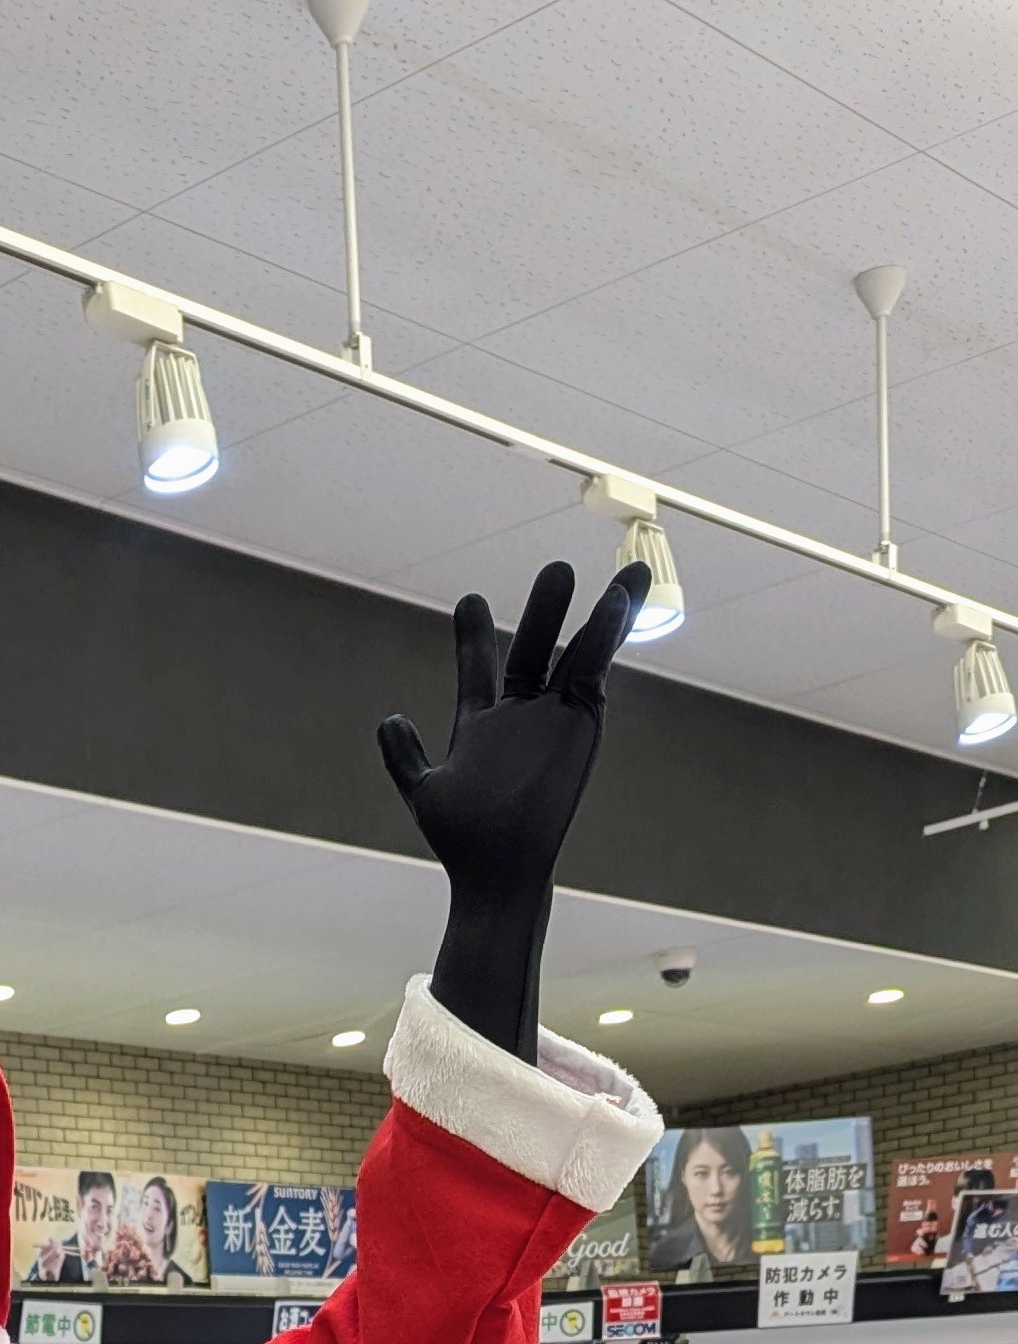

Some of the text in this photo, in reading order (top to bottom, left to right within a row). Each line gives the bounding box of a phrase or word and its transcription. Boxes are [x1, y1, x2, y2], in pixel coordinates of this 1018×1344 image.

[785, 1166, 864, 1192] 体脂肪を
[273, 1186, 319, 1200] SUNTORY
[786, 1198, 841, 1223] 減らす。
[567, 1232, 631, 1268] Good
[766, 1264, 848, 1285] 防犯カメラ
[773, 1288, 840, 1308] 作動中
[25, 1313, 72, 1338] 節電中
[606, 1323, 657, 1338] SECOM
